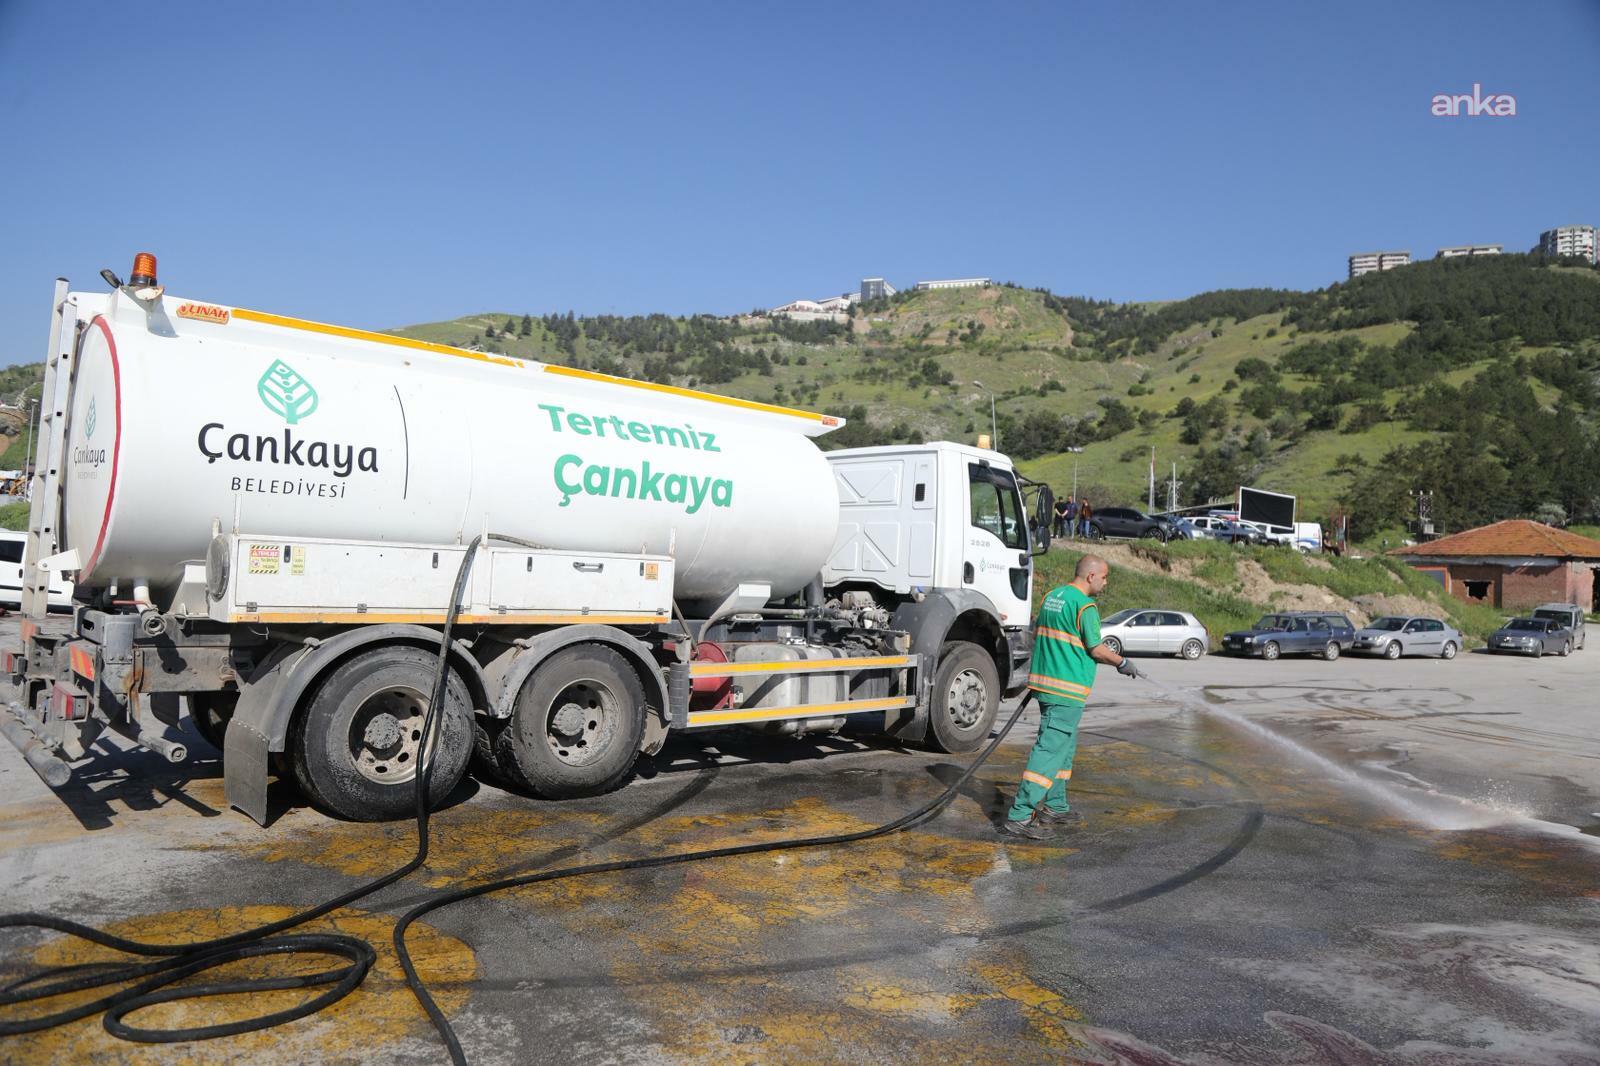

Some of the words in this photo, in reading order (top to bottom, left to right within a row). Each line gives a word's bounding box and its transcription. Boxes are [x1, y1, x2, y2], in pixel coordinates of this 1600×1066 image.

[198, 423, 379, 478] Çankaya
[537, 403, 722, 453] Tertemiz
[231, 477, 346, 499] BELEDİYESİ
[553, 454, 733, 515] Çankaya
